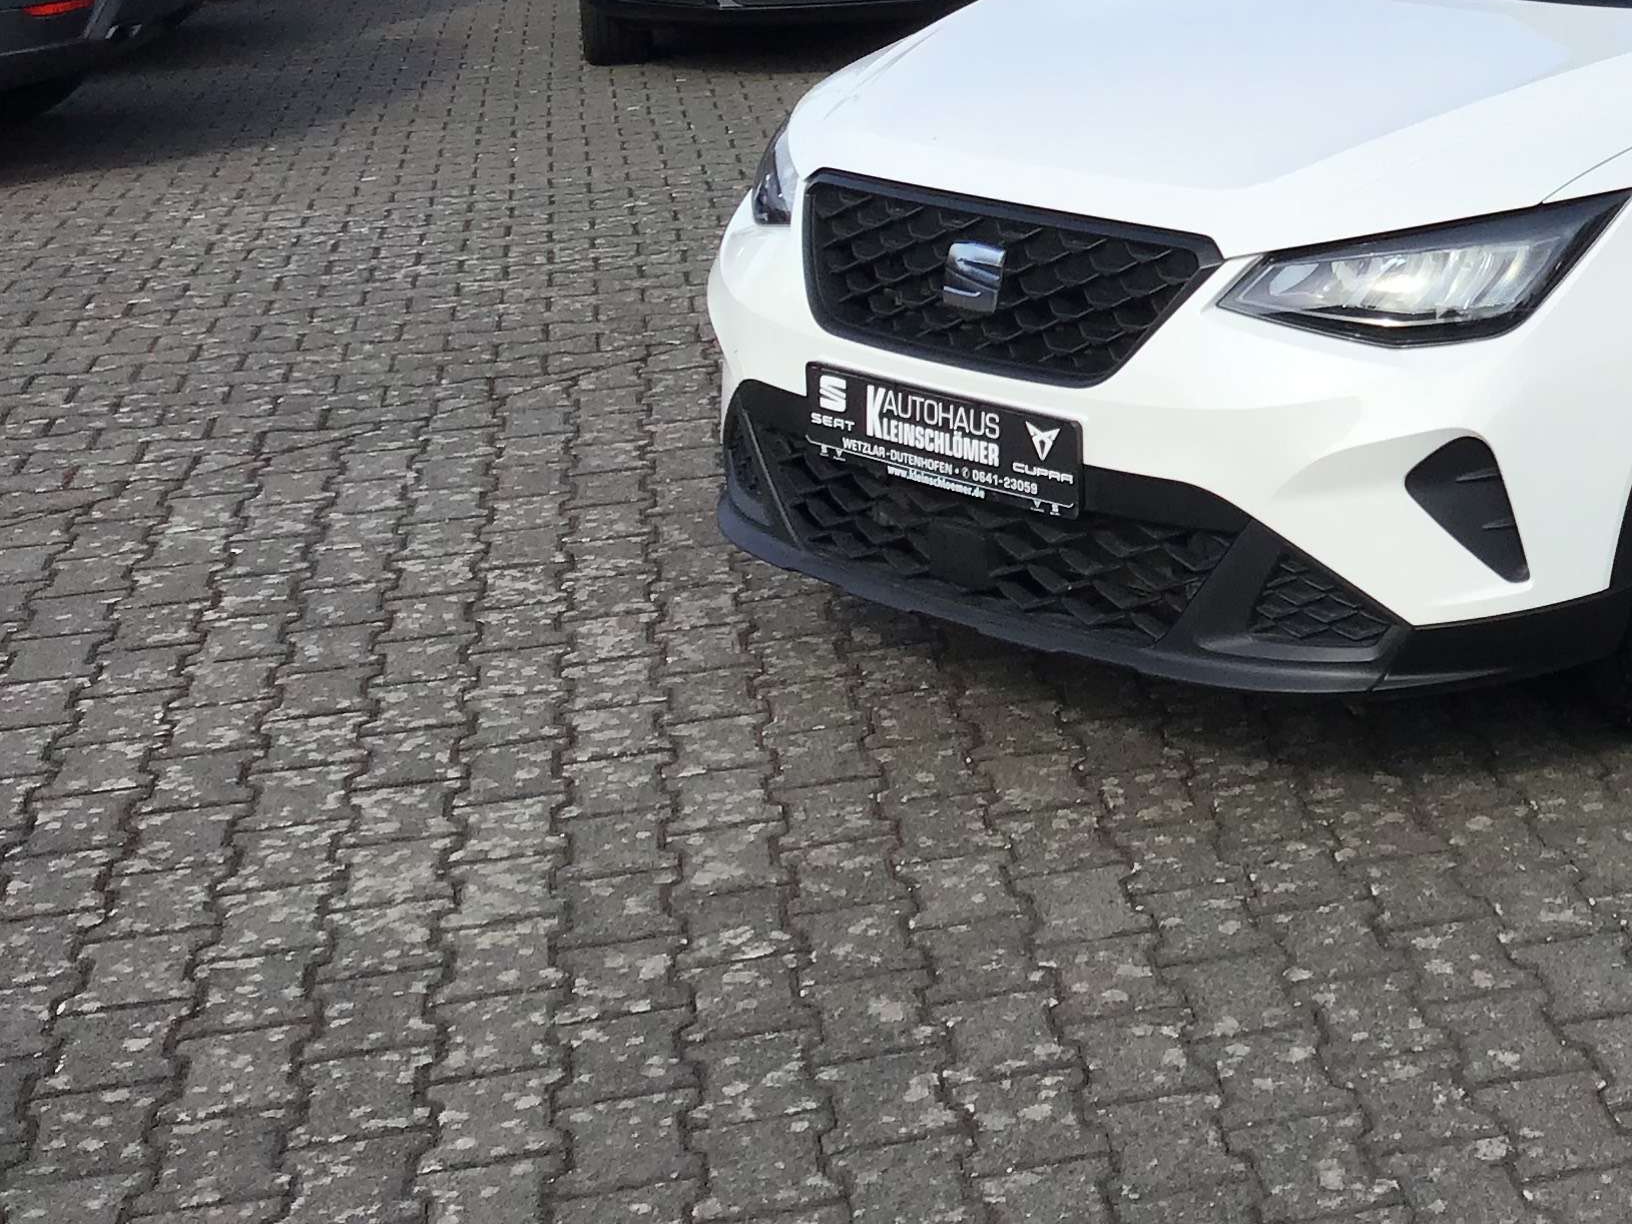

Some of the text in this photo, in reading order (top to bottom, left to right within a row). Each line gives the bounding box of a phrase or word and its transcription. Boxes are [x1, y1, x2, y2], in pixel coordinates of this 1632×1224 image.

[811, 412, 856, 432] SEAT
[865, 384, 1000, 468] KLEINSCHLÖMER
[883, 389, 1000, 439] AUTOHAUS
[1012, 461, 1074, 485] CUPRA
